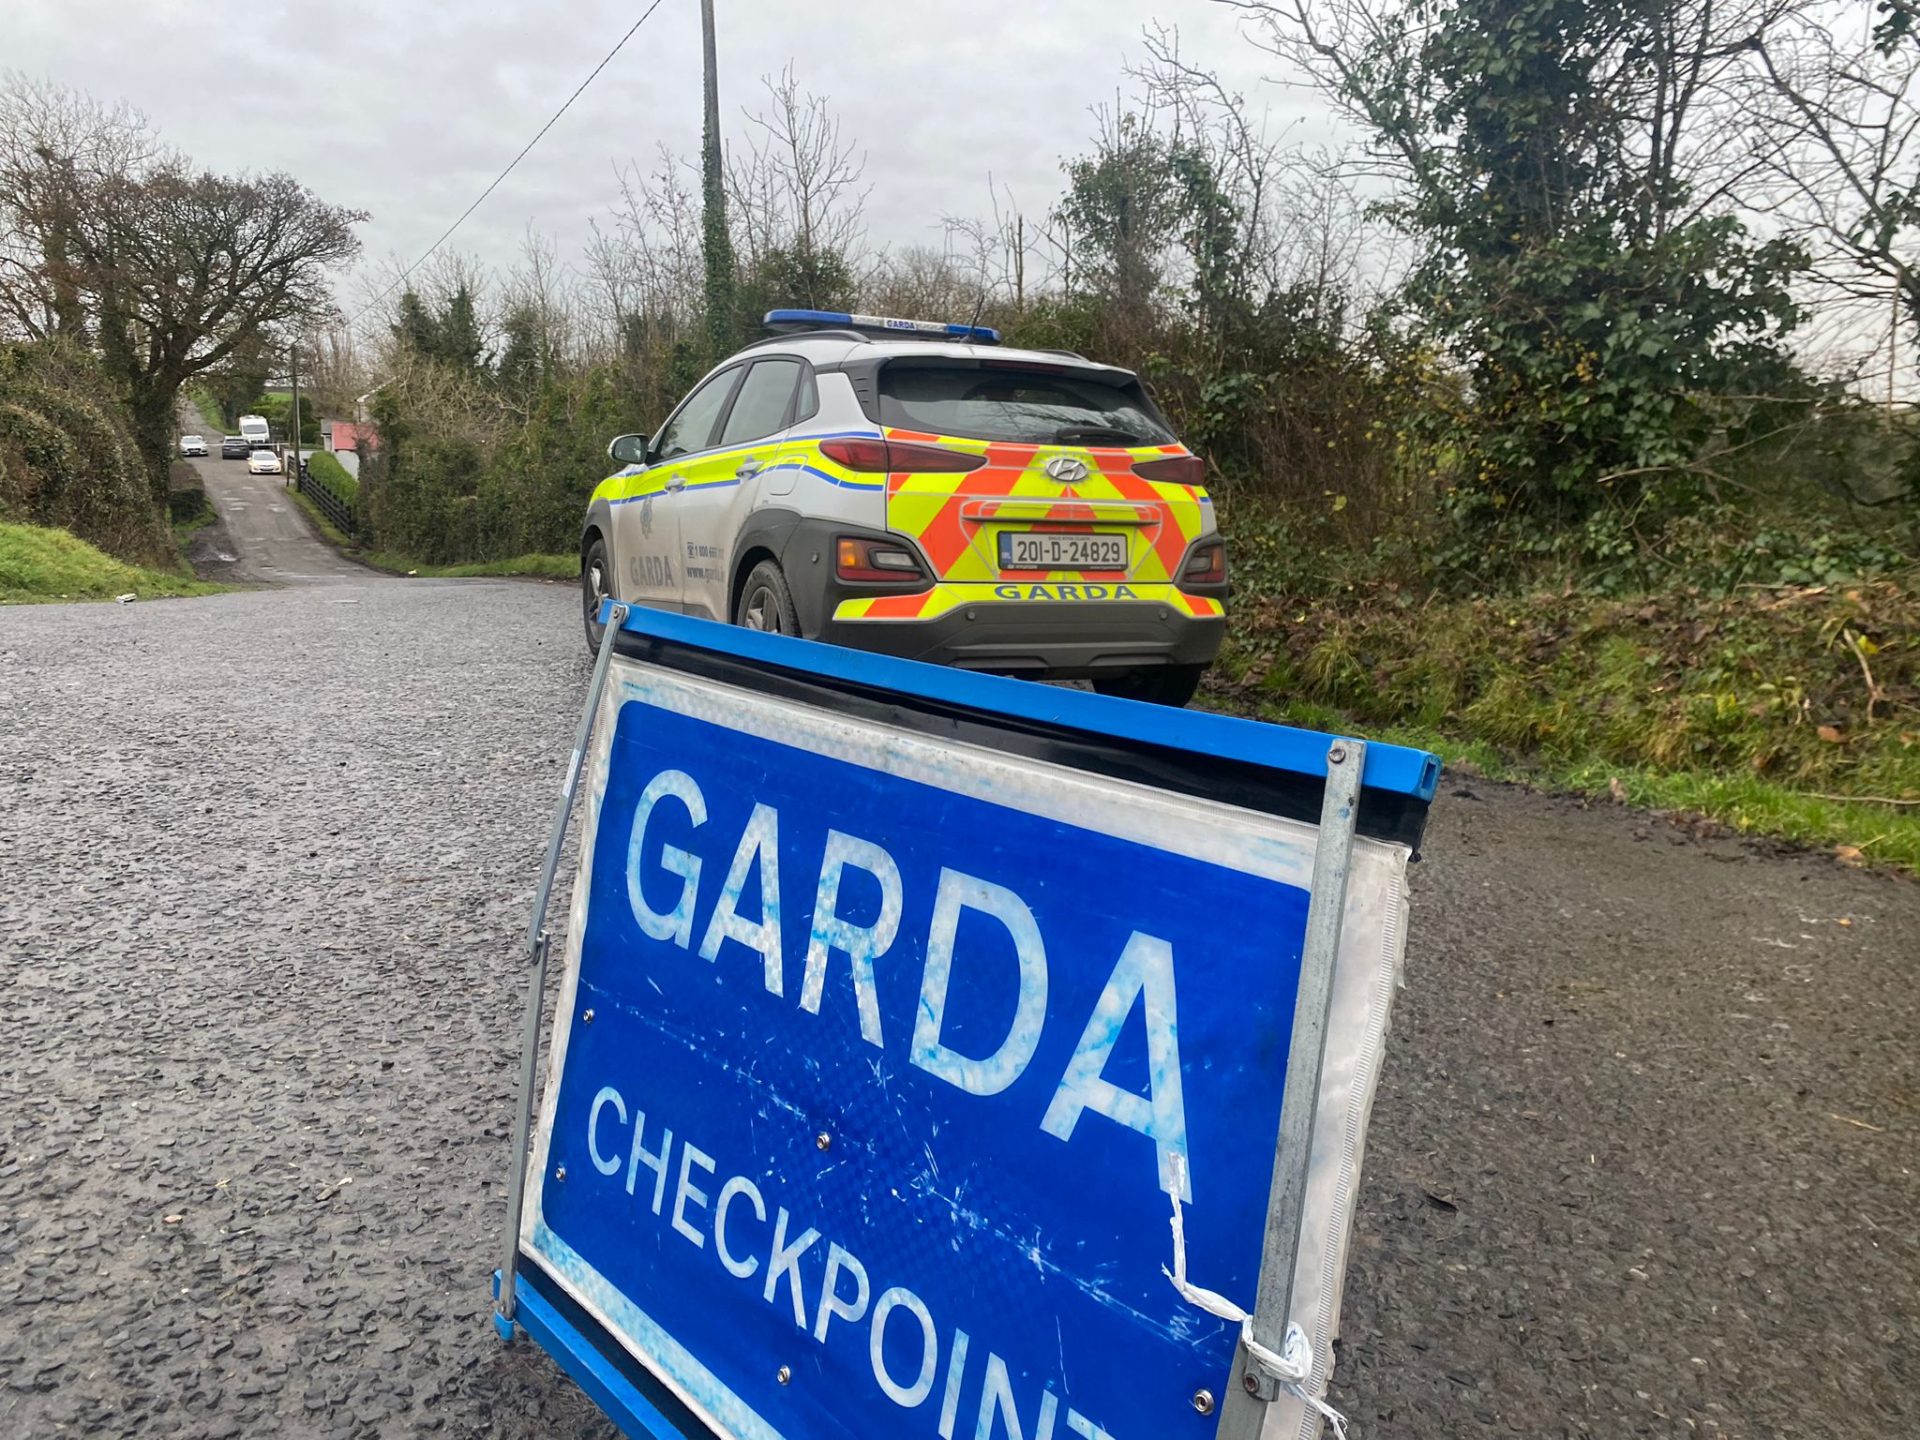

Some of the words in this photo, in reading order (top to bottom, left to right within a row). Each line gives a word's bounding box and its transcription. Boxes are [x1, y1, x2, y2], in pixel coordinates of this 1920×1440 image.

[886, 320, 915, 329] GARDA
[1017, 541, 1120, 562] 201-D-24829
[630, 555, 674, 587] GARDA
[994, 585, 1138, 600] GARDA
[625, 769, 1193, 1204] GARDA
[587, 1086, 1117, 1440] CHECKPOIN
